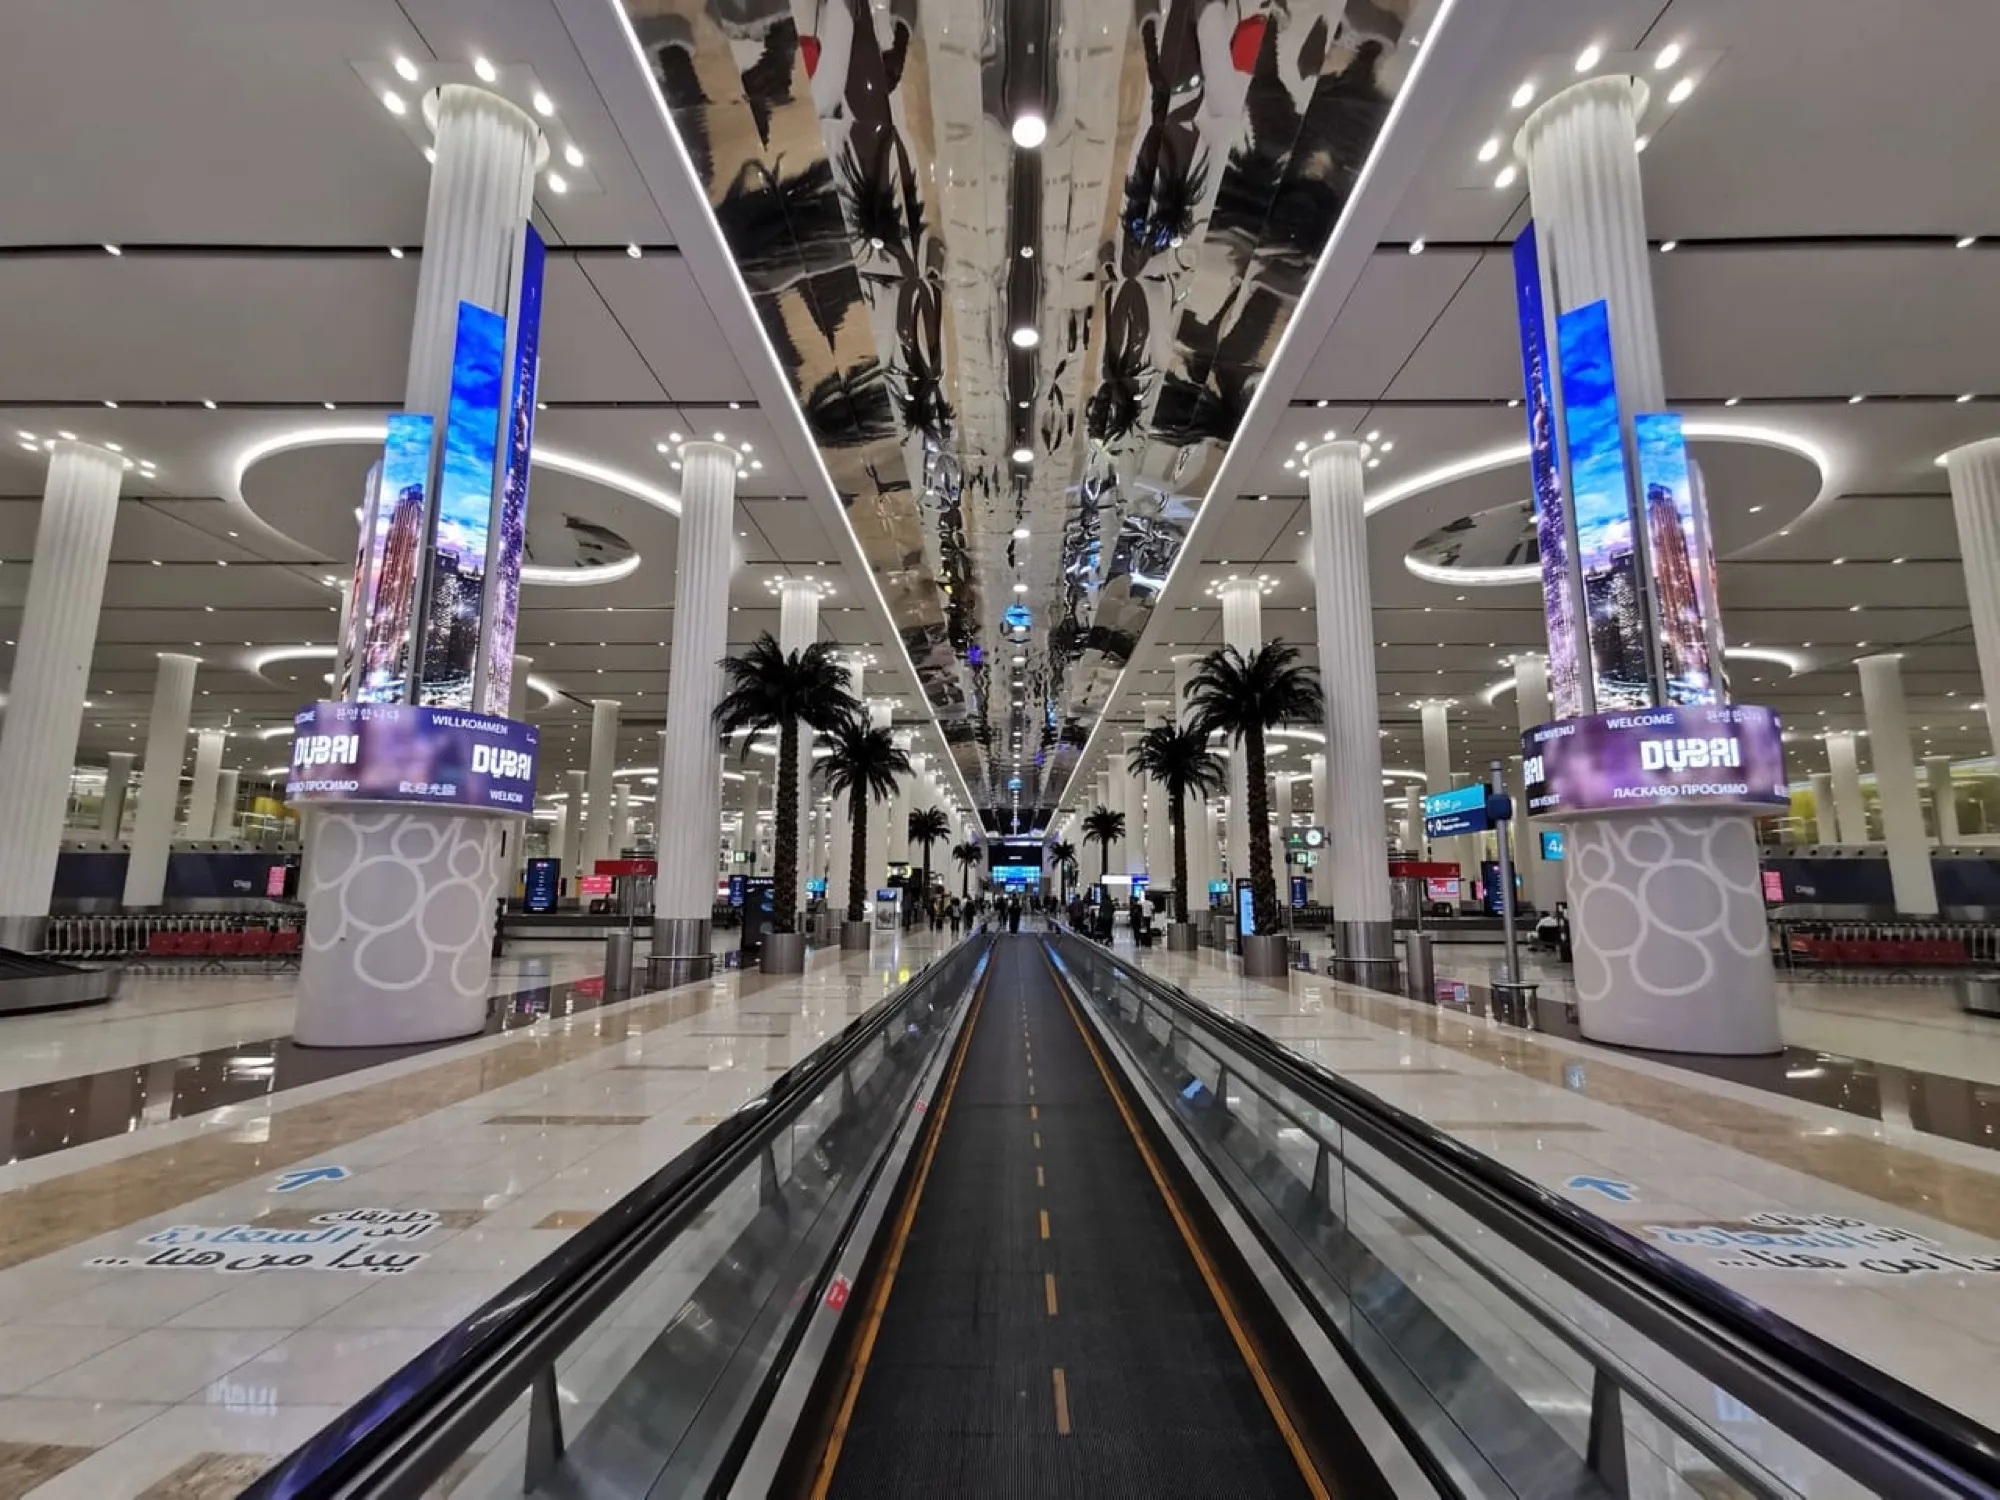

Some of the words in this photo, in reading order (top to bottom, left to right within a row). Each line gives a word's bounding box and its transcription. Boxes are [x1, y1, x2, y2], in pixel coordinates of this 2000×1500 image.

[432, 715, 509, 735] WILLKOMMEN
[1606, 714, 1674, 729] WELCOME
[293, 735, 359, 769] DUBAI
[1640, 737, 1740, 772] DUBAI
[472, 744, 532, 781] DUBAI
[1681, 783, 1748, 795] ПРОСИМО
[225, 1253, 313, 1270] من
[1860, 1258, 1939, 1273] من
